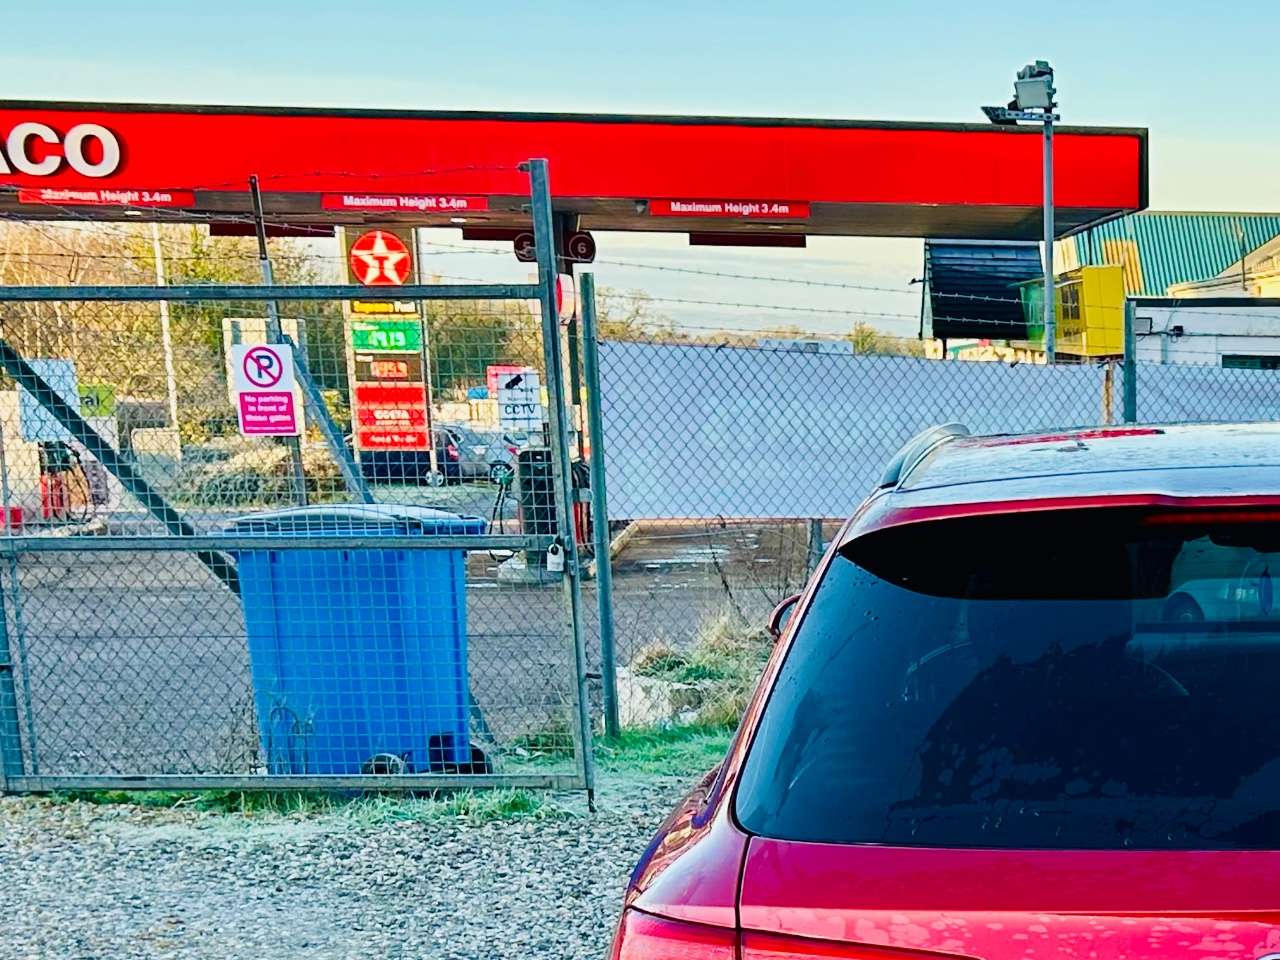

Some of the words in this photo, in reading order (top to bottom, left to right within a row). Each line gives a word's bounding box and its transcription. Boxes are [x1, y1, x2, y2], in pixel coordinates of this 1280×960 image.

[0, 122, 120, 177] CO
[41, 189, 98, 201] Maximum
[100, 190, 139, 204] Height
[142, 192, 171, 202] 3.4m
[343, 195, 397, 207] Maximum
[399, 196, 436, 209] Height
[438, 197, 467, 208] 3.4m
[670, 201, 722, 213] Maximum
[724, 202, 759, 215] Height
[761, 203, 789, 214] 3.4m
[577, 242, 587, 255] 6
[257, 396, 288, 404] parking
[504, 404, 536, 415] CCTV
